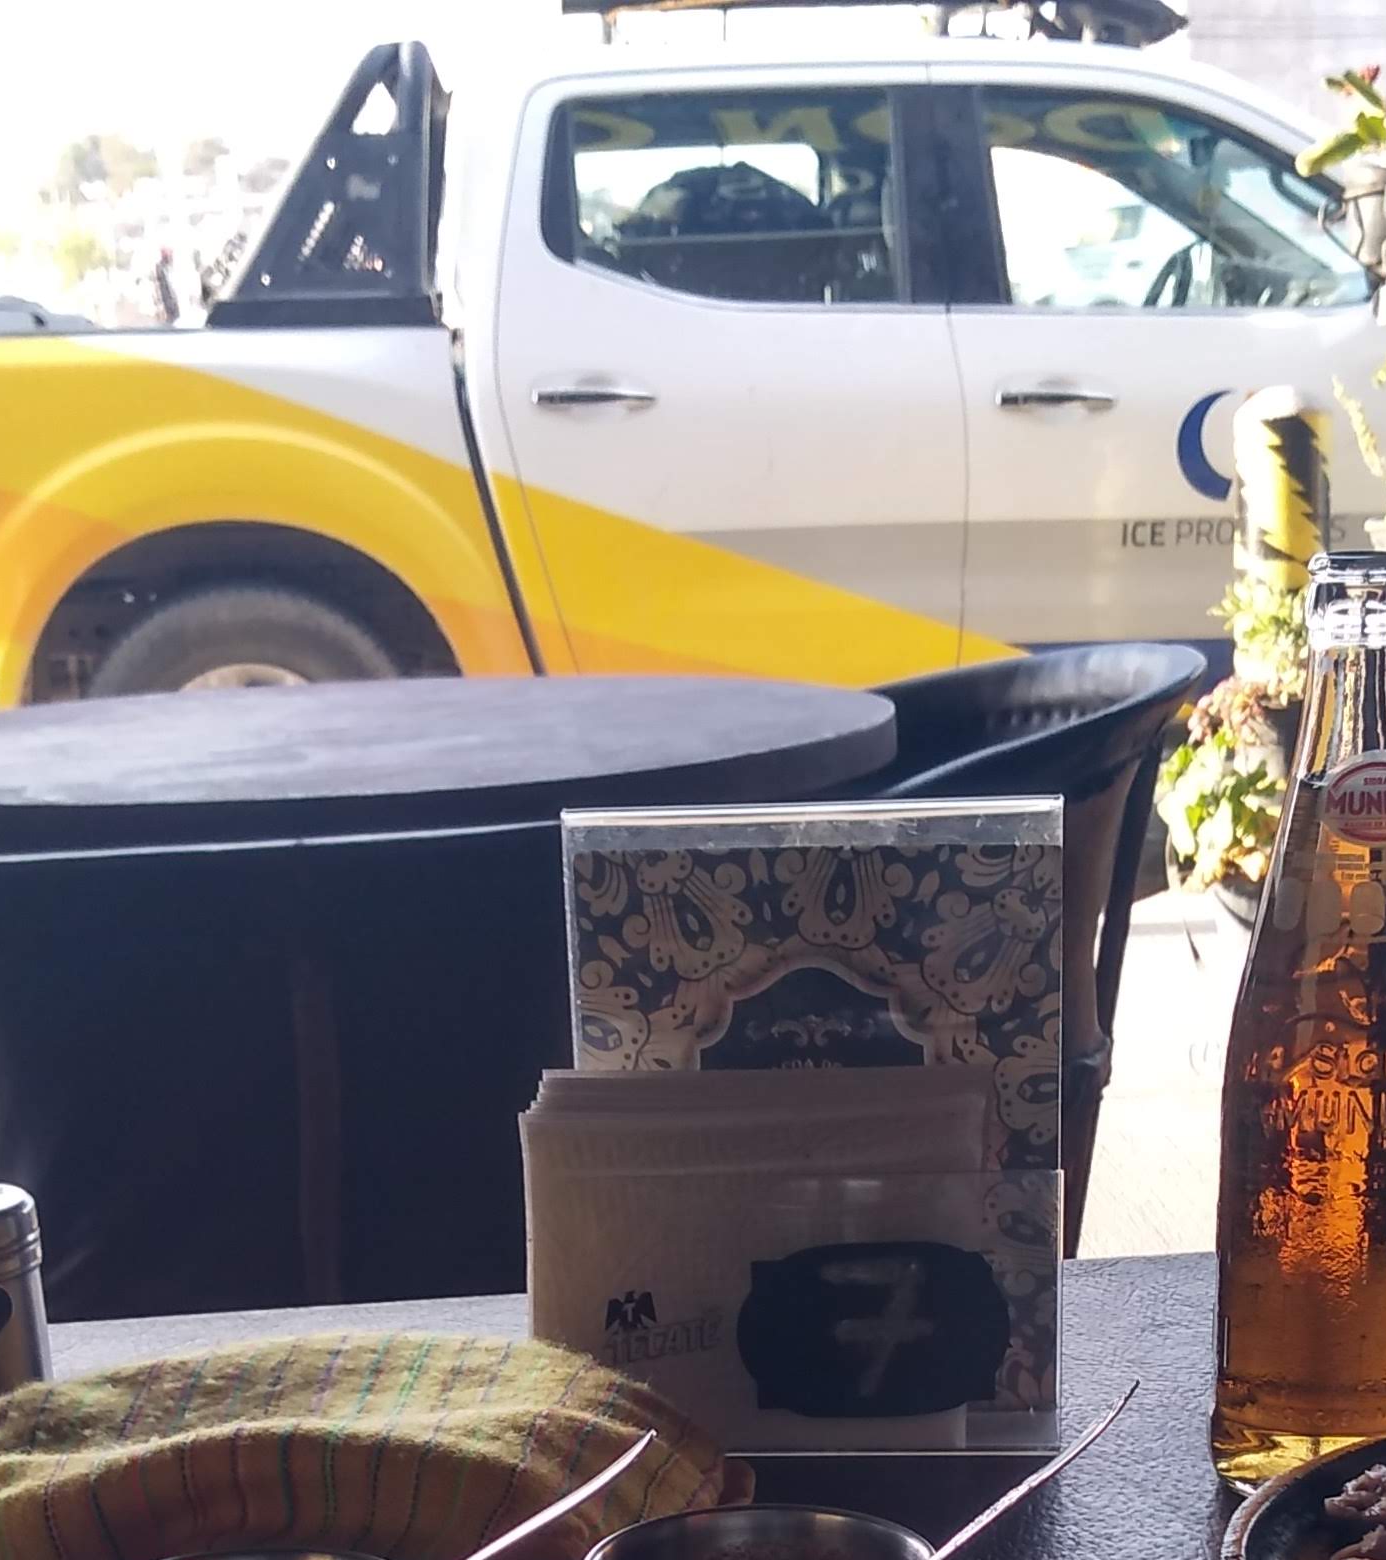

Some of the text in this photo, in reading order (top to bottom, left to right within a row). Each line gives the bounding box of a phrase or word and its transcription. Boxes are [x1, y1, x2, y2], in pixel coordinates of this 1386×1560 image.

[1121, 520, 1166, 547] ICE
[605, 1315, 720, 1366] TECATE
[819, 1257, 935, 1399] 7
